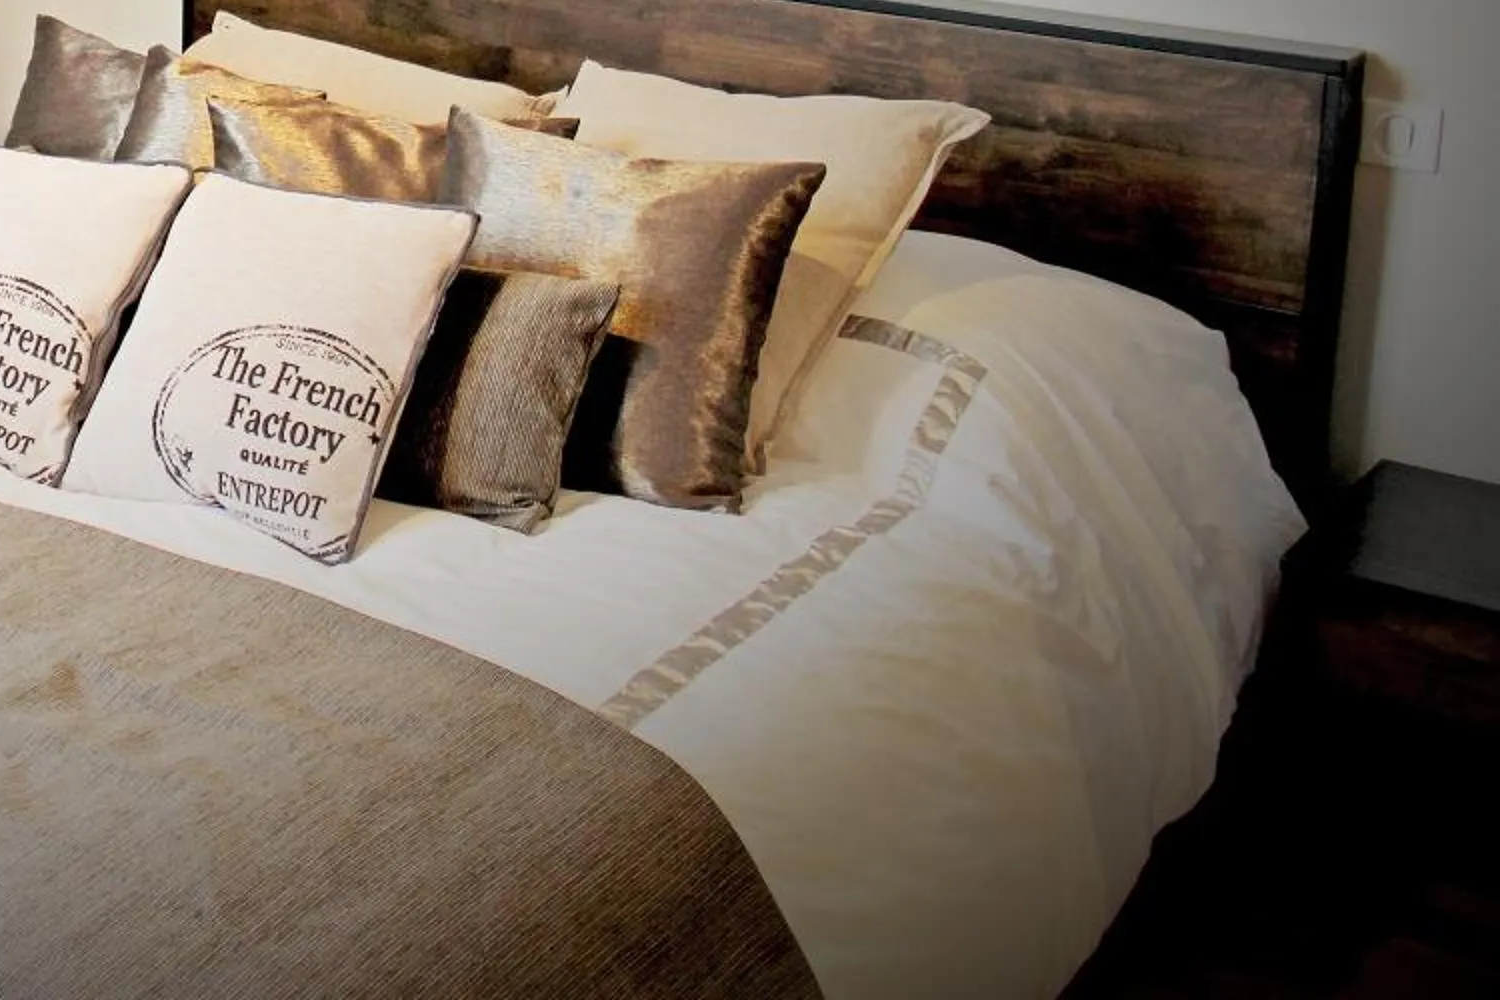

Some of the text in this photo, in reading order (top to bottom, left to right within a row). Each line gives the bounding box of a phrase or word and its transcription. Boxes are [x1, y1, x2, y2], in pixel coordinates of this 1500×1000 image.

[212, 344, 381, 429] The French
[225, 393, 346, 464] Factory
[240, 449, 309, 475] QUALITÉ
[217, 471, 327, 521] ENTREPOT
